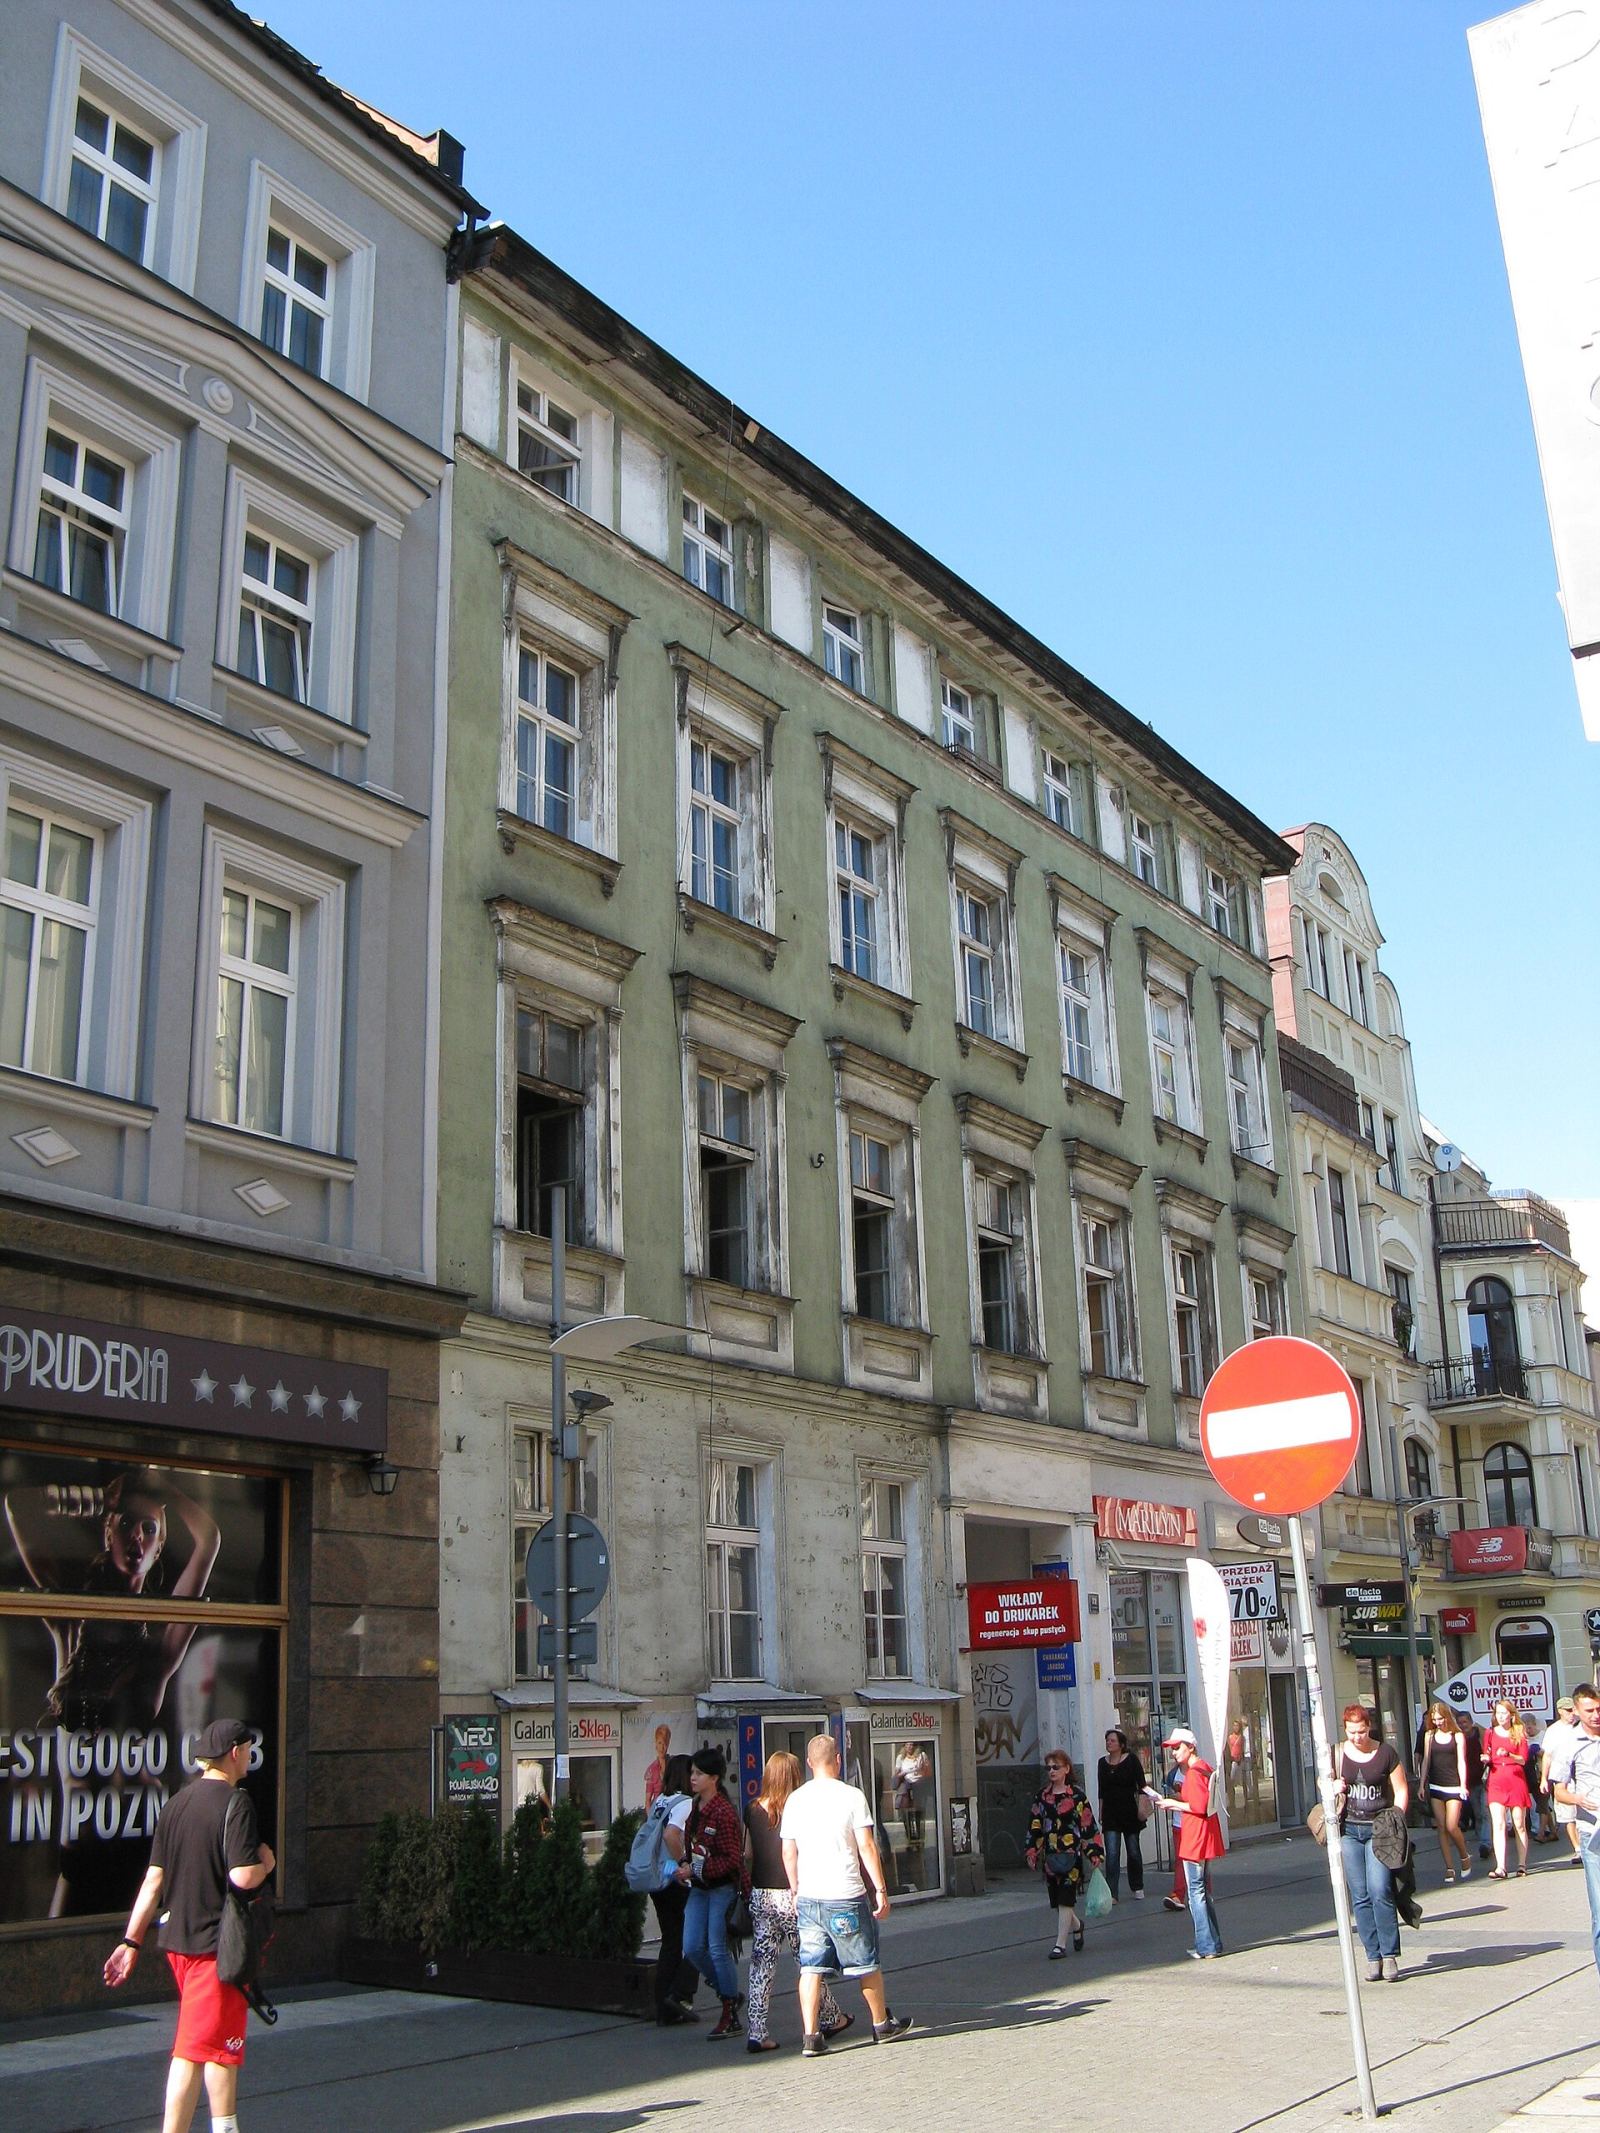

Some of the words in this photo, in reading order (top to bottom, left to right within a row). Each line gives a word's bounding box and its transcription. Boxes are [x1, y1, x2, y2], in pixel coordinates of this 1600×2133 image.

[0, 1325, 169, 1404] PRUDERIA
[1117, 1509, 1182, 1537] MARILYN
[1484, 1554, 1514, 1563] balance
[1218, 1562, 1273, 1577] PRZEDAŻ
[1223, 1576, 1264, 1587] SIĄŻEK
[998, 1591, 1043, 1608] WKŁADY
[985, 1610, 1000, 1624] DO
[1003, 1606, 1059, 1622] DRUKAREK
[1352, 1603, 1405, 1620] SUBWAY
[979, 1627, 1020, 1640] regeneracja
[1022, 1627, 1039, 1637] skup
[1040, 1624, 1066, 1636] pustych
[1487, 1673, 1529, 1686] WIELKA
[1475, 1682, 1544, 1699] WYPRZEDAŻ
[1487, 1697, 1533, 1711] KŻEK
[514, 1718, 619, 1742] GalantiaSklep.eu
[69, 1727, 168, 1778] GOGO
[181, 1728, 264, 1776] CB
[485, 1775, 499, 1792] 20
[10, 1788, 51, 1842] IN
[69, 1787, 170, 1841] POZN
